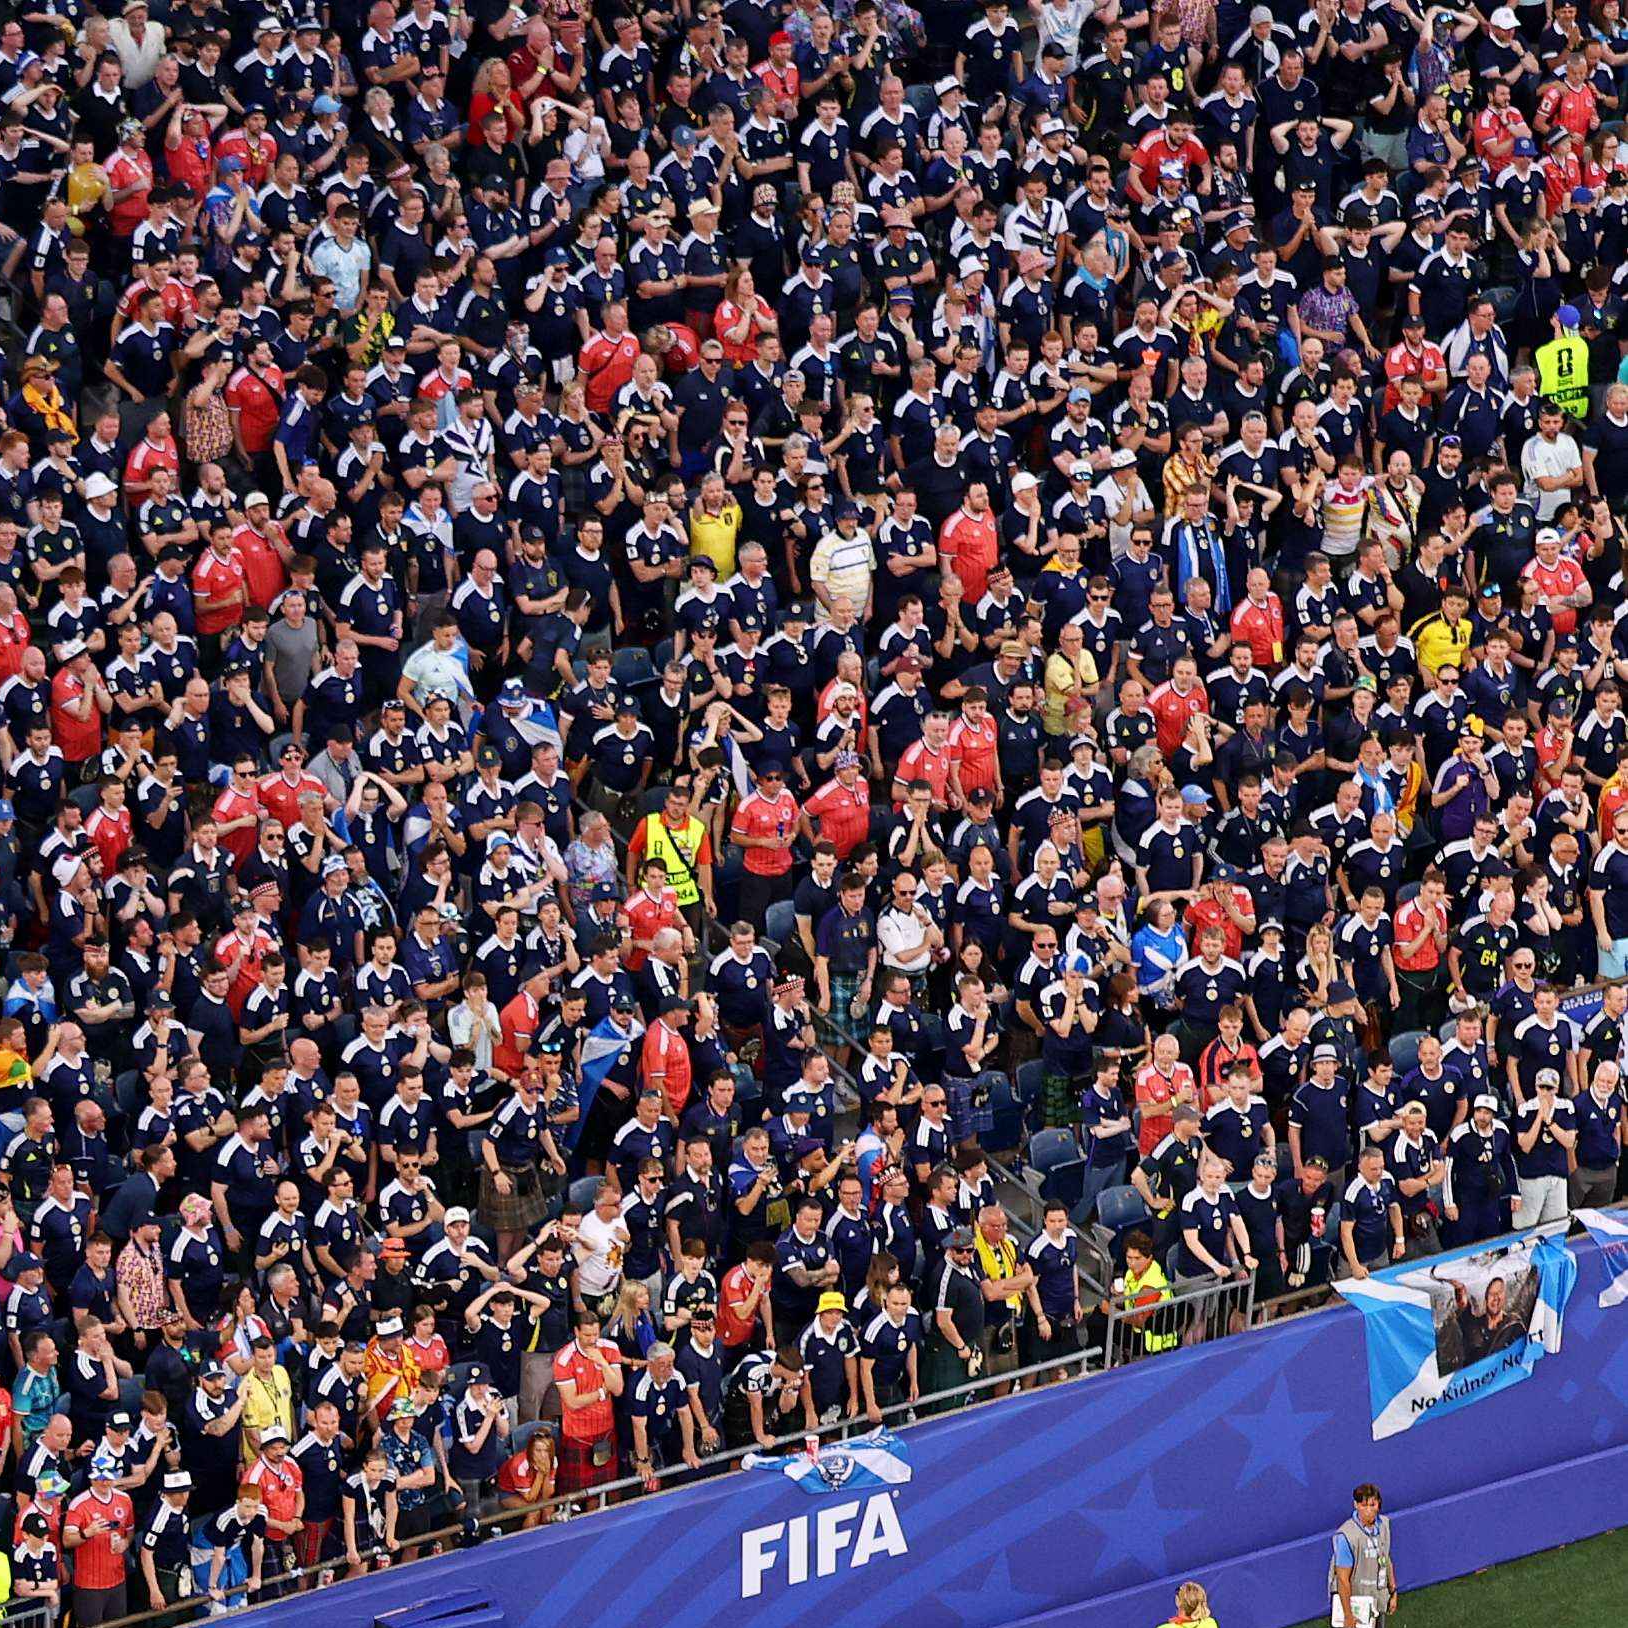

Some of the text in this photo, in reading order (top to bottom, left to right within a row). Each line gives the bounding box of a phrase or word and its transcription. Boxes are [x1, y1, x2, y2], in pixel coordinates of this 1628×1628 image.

[1480, 949, 1498, 967] 64
[1411, 1396, 1437, 1413] No
[1442, 1366, 1499, 1404] Kidney
[742, 1492, 909, 1598] FIFA
